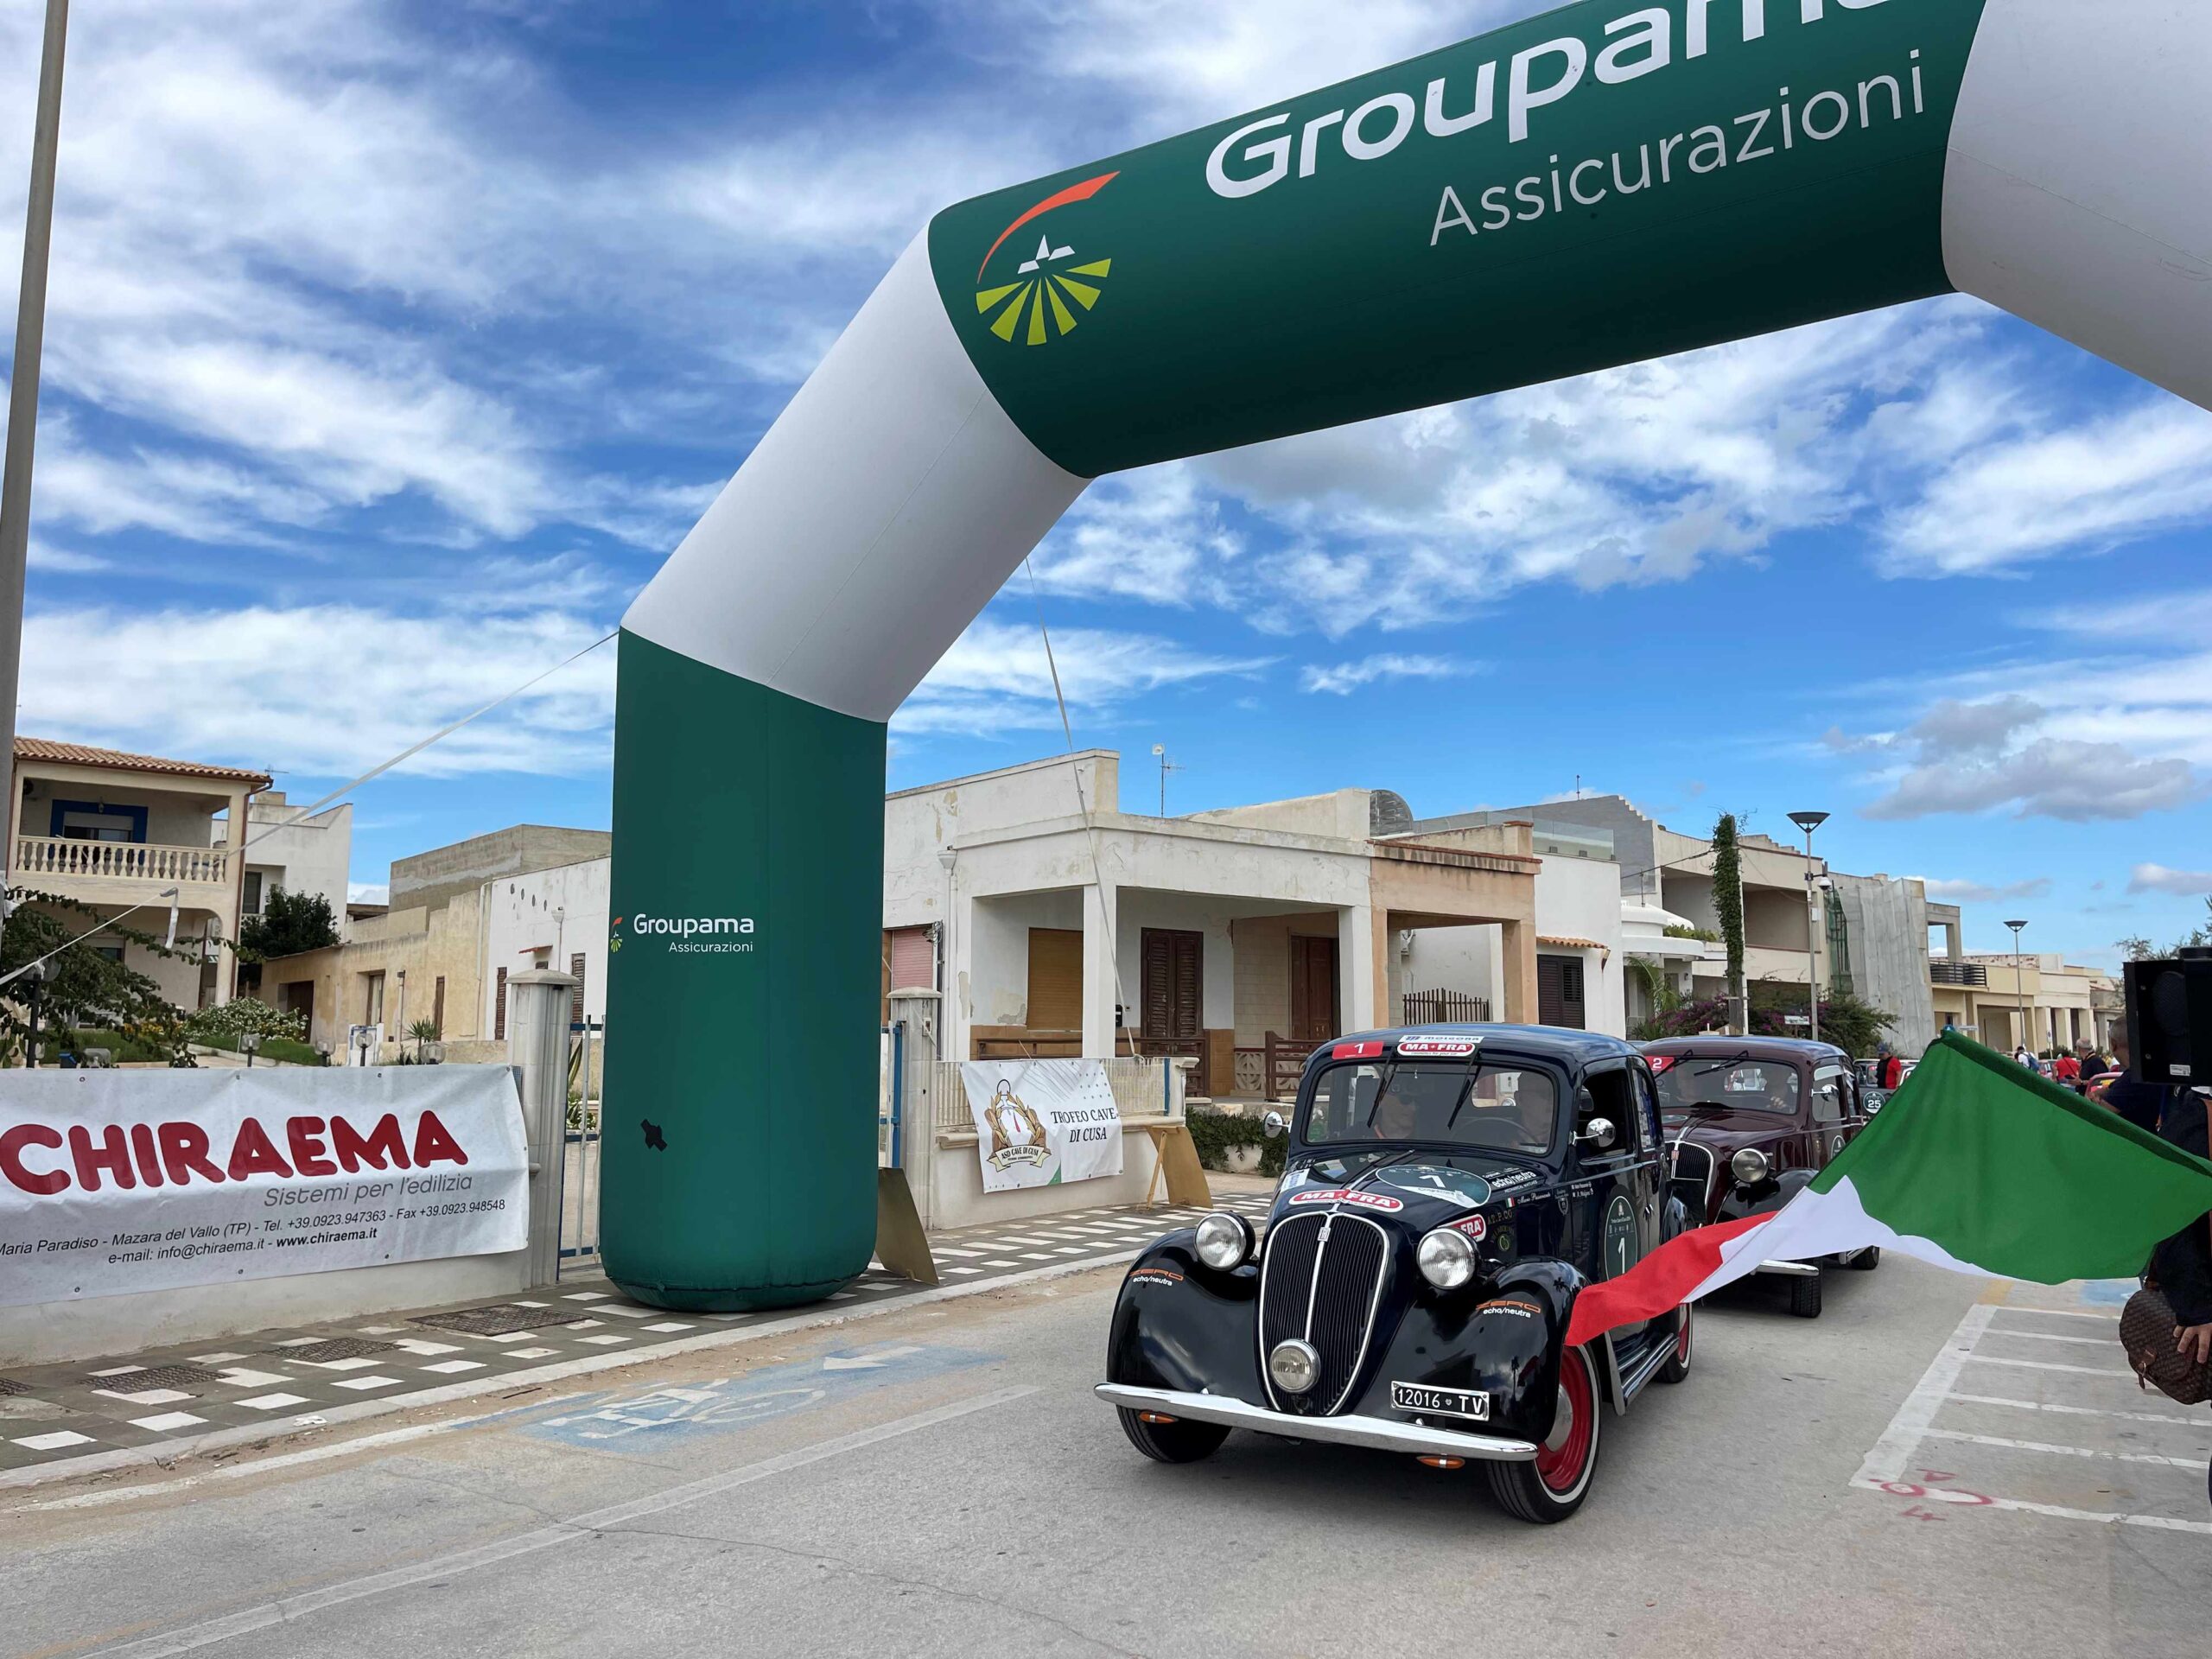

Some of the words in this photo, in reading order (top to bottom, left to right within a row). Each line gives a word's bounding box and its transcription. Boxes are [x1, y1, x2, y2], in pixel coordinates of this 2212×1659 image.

[1206, 0, 1894, 198] Groupam
[1430, 48, 1923, 245] Assicurazioni
[633, 913, 754, 938] Groupama
[668, 941, 753, 952] Assicurazioni
[1354, 1043, 1364, 1053] 1
[1652, 1058, 1662, 1069] 2
[1867, 1099, 1881, 1109] 25
[1050, 1109, 1089, 1124] TROFEO
[1090, 1107, 1116, 1122] CAVE
[1069, 1129, 1081, 1143] DI
[1082, 1126, 1108, 1141] CUSA
[0, 1109, 468, 1196] CHIRAEMA
[264, 1183, 350, 1207] Sistemi
[353, 1182, 393, 1204] per
[399, 1173, 474, 1196] l'edilizia
[1491, 1171, 1537, 1188] echo/neutra
[36, 1237, 99, 1253] Paradiso
[111, 1232, 162, 1246] Mazara
[165, 1228, 186, 1241] del
[190, 1224, 219, 1238] Vallo
[223, 1221, 251, 1238] (TP)
[264, 1219, 283, 1232] Tel.
[287, 1210, 387, 1229] +39.0923.947363
[396, 1208, 416, 1220] Fax
[419, 1199, 505, 1217] +39.0923.948548
[108, 1249, 154, 1264] e-mail:
[157, 1237, 264, 1261] info@chiraema.it
[276, 1228, 378, 1248] www.chiraema.it
[1618, 1236, 1625, 1274] 1
[1133, 1275, 1173, 1287] echo/neutra
[1483, 1306, 1531, 1319] echo/neutra
[1397, 1389, 1440, 1408] 12016
[1458, 1395, 1483, 1414] TV
